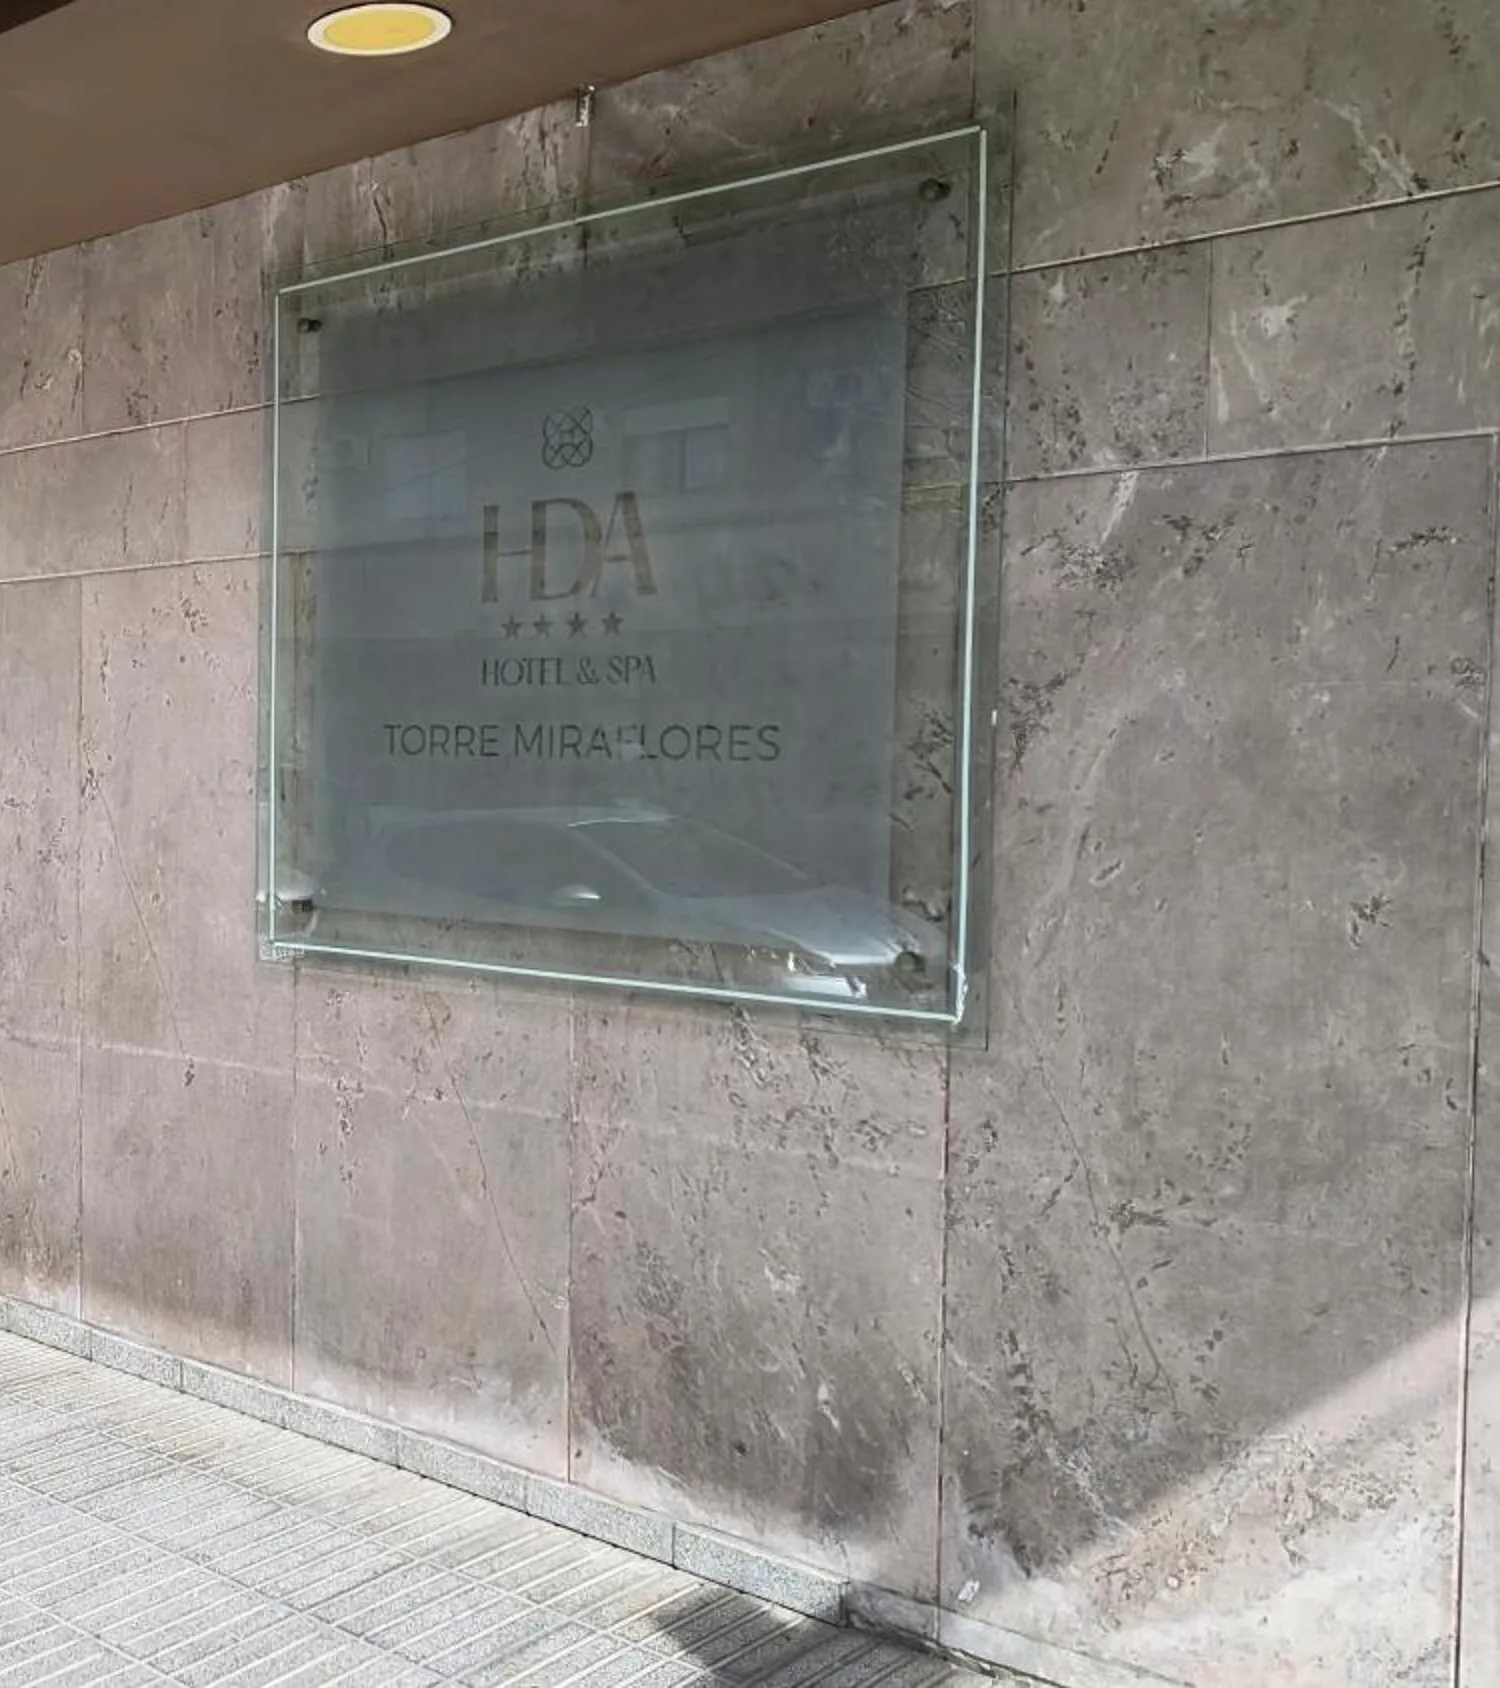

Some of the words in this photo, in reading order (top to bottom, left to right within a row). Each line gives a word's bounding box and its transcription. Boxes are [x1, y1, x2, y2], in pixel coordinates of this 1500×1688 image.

[480, 490, 659, 604] HDA
[481, 656, 572, 687] HOTEL
[576, 655, 600, 686] &
[606, 654, 657, 686] SPA
[383, 724, 500, 757] TORRE
[514, 723, 781, 762] MIRAFLORES
